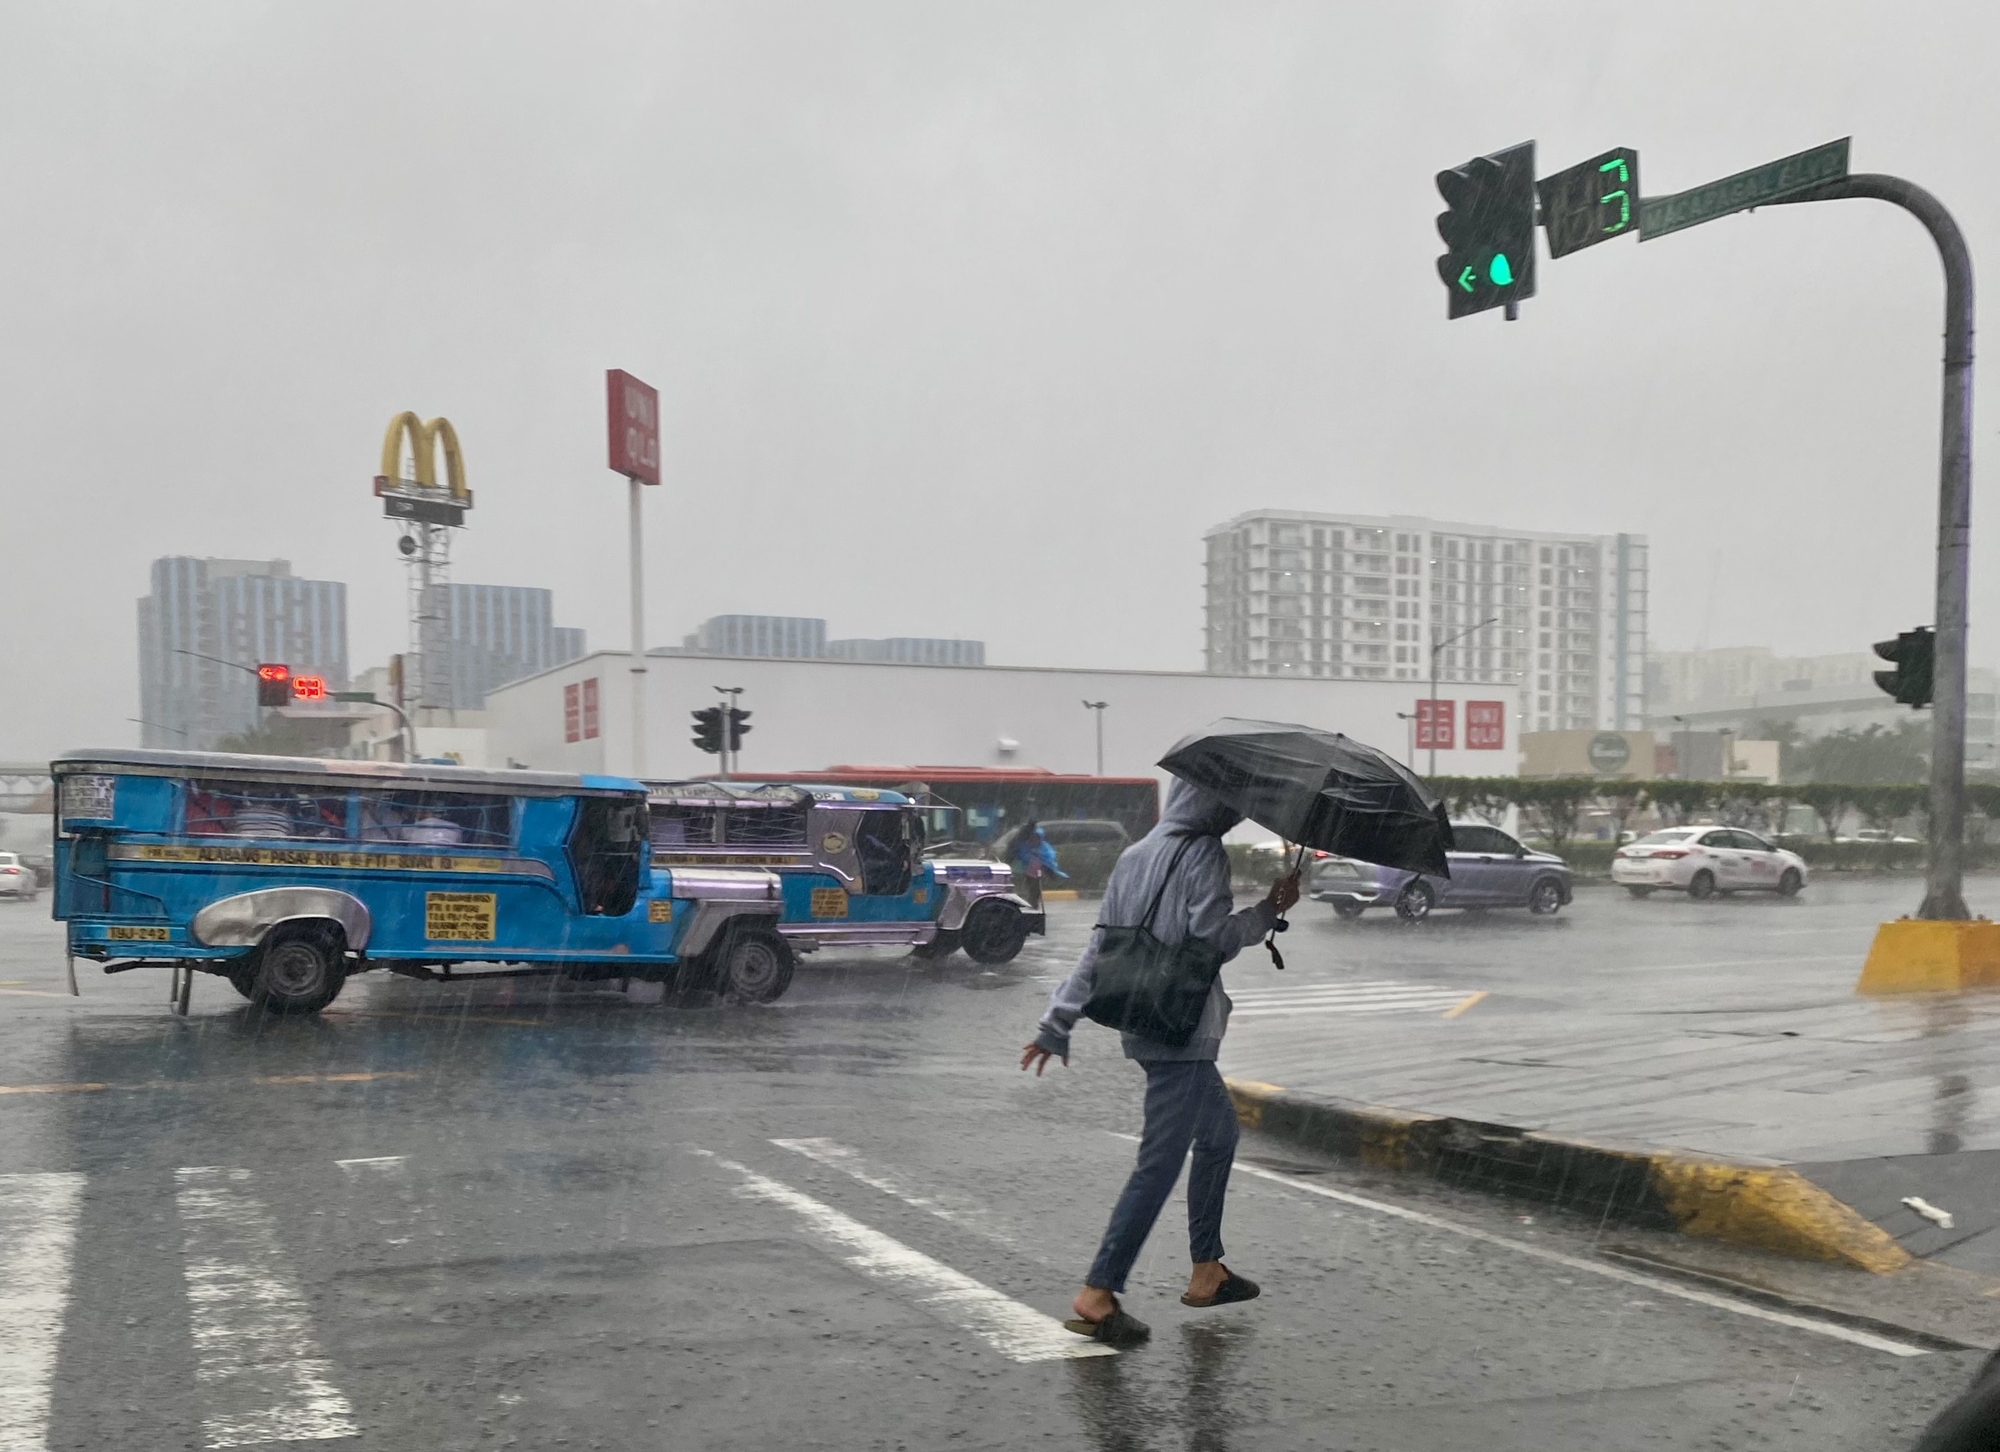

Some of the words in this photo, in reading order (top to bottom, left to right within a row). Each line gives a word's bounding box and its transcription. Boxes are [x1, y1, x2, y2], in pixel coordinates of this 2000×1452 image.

[1470, 708, 1499, 723] UNI
[1470, 727, 1500, 745] QLO
[199, 848, 259, 862] ALABANG
[270, 850, 308, 863] PASAY
